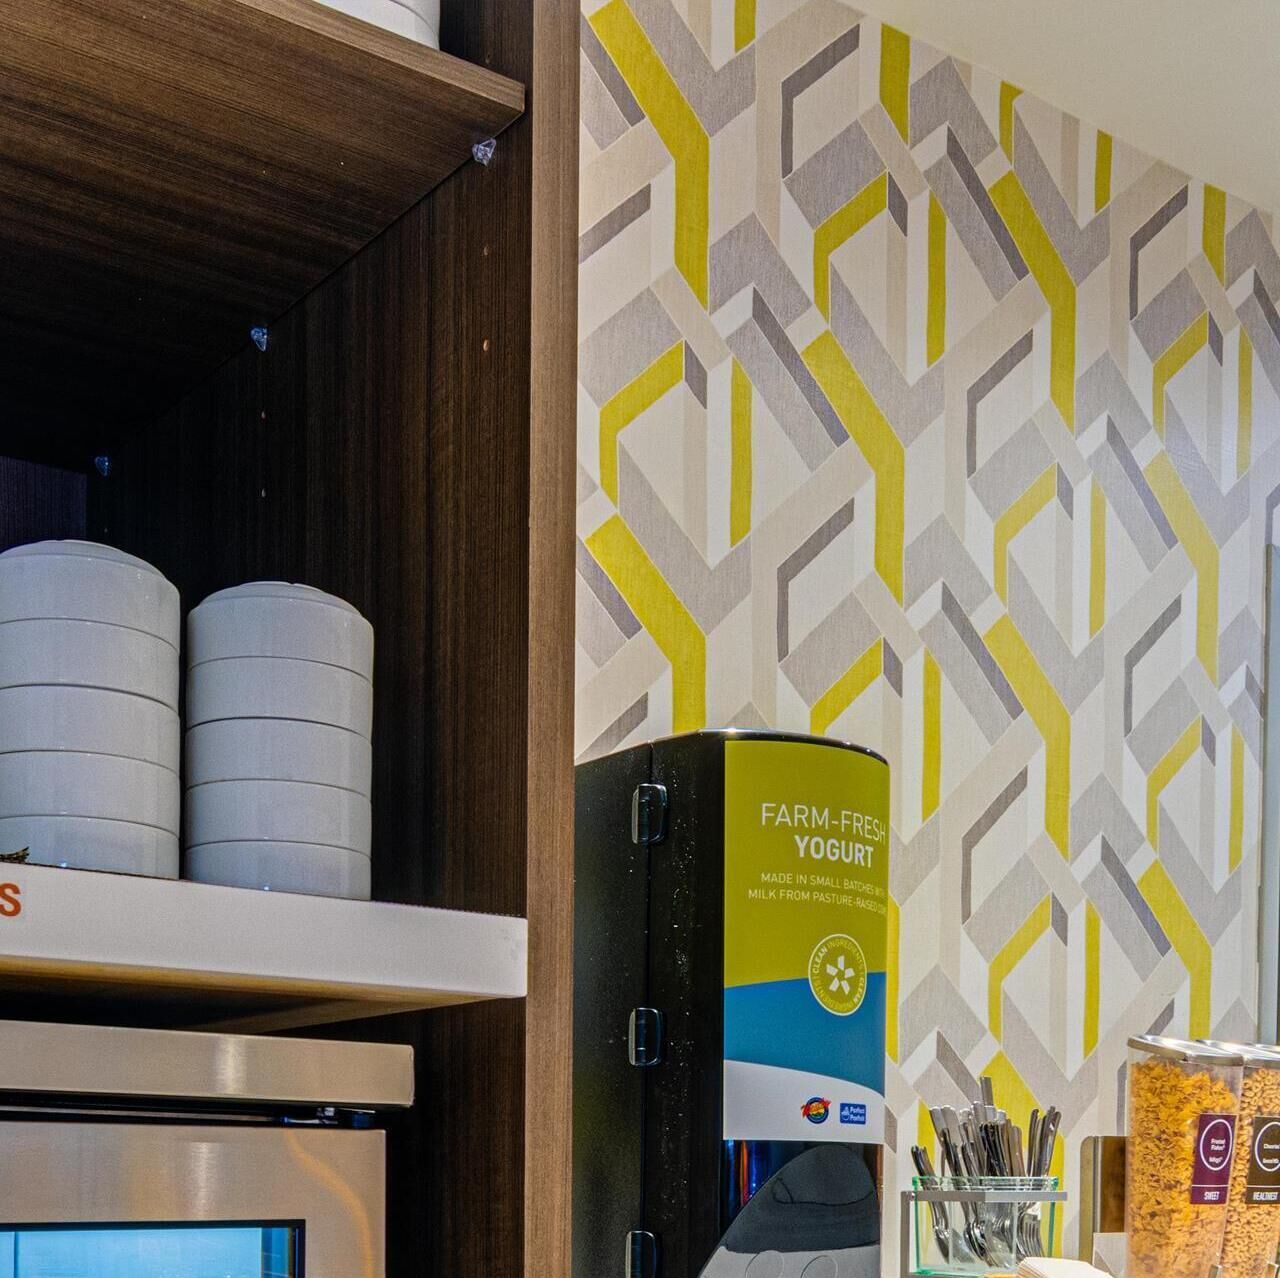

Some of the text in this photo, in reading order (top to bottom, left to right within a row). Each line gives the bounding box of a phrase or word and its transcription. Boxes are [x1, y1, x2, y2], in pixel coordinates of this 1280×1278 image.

[761, 803, 886, 845] FARM-FRESH
[794, 835, 874, 868] YOGURT
[748, 888, 778, 901] MILK
[780, 889, 810, 902] FROM
[761, 872, 793, 884] MADE
[796, 873, 808, 885] IN
[810, 875, 841, 889] SMALL
[843, 878, 875, 896] BATCHES
